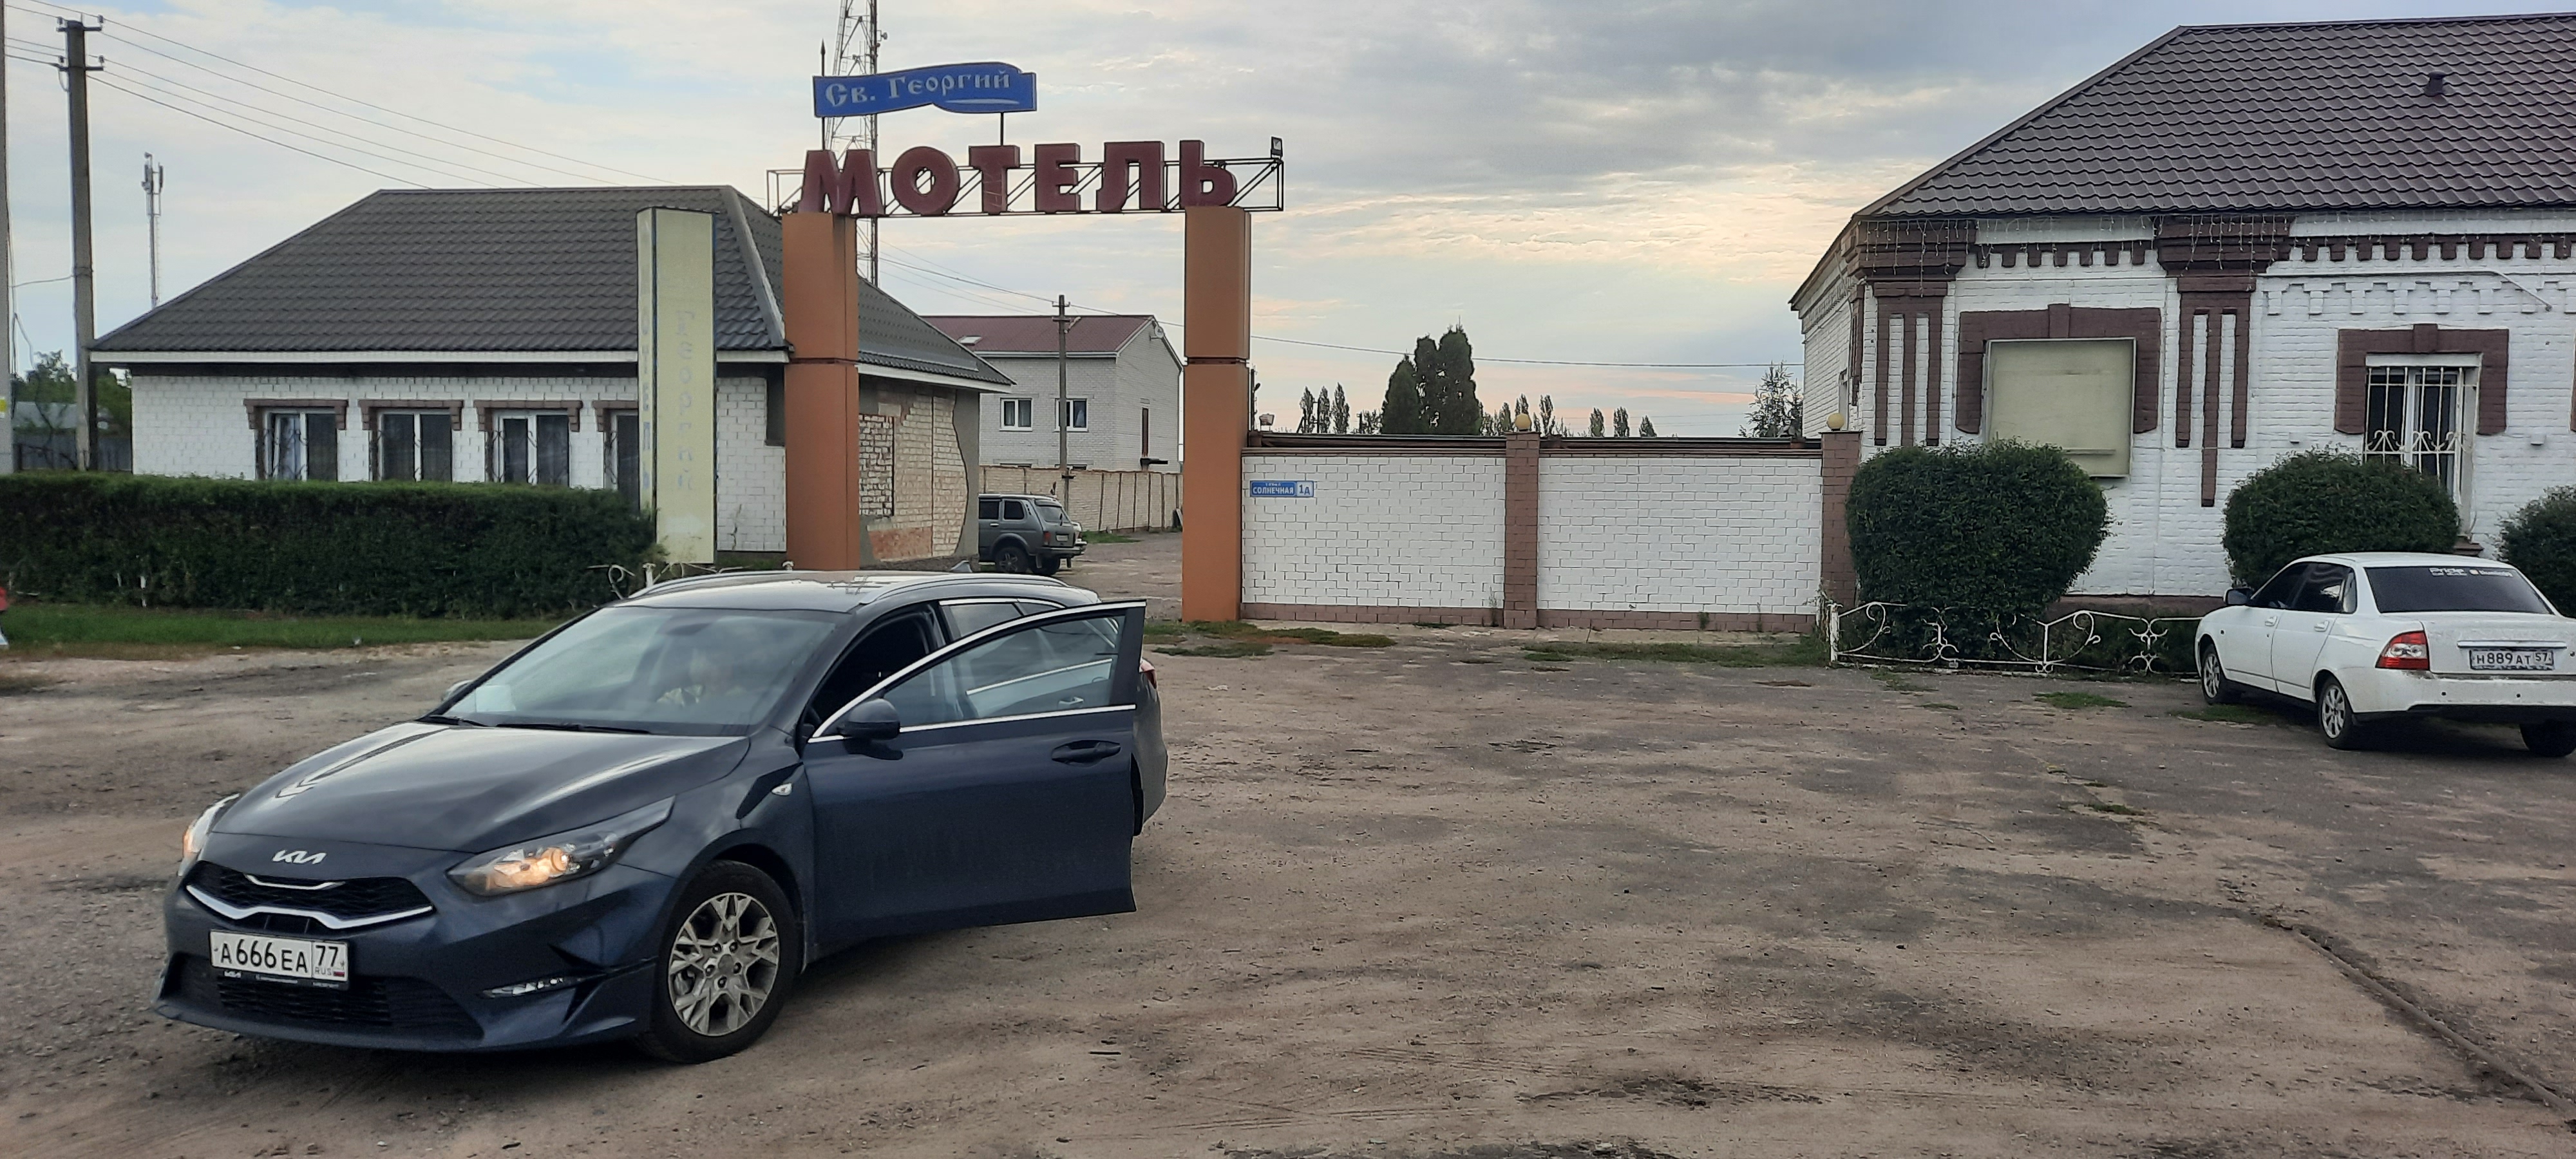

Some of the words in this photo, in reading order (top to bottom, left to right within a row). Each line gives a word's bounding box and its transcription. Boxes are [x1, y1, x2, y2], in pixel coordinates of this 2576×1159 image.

[825, 82, 876, 108] Св.
[889, 69, 1010, 100] Георгий
[800, 140, 1238, 216] МОТЕЛЬ
[2476, 652, 2531, 664] Н889АТ
[2535, 652, 2548, 662] 57
[271, 849, 327, 865] KIA
[220, 939, 308, 974] А666ЕА
[316, 945, 339, 967] 77
[314, 966, 332, 975] RUS
